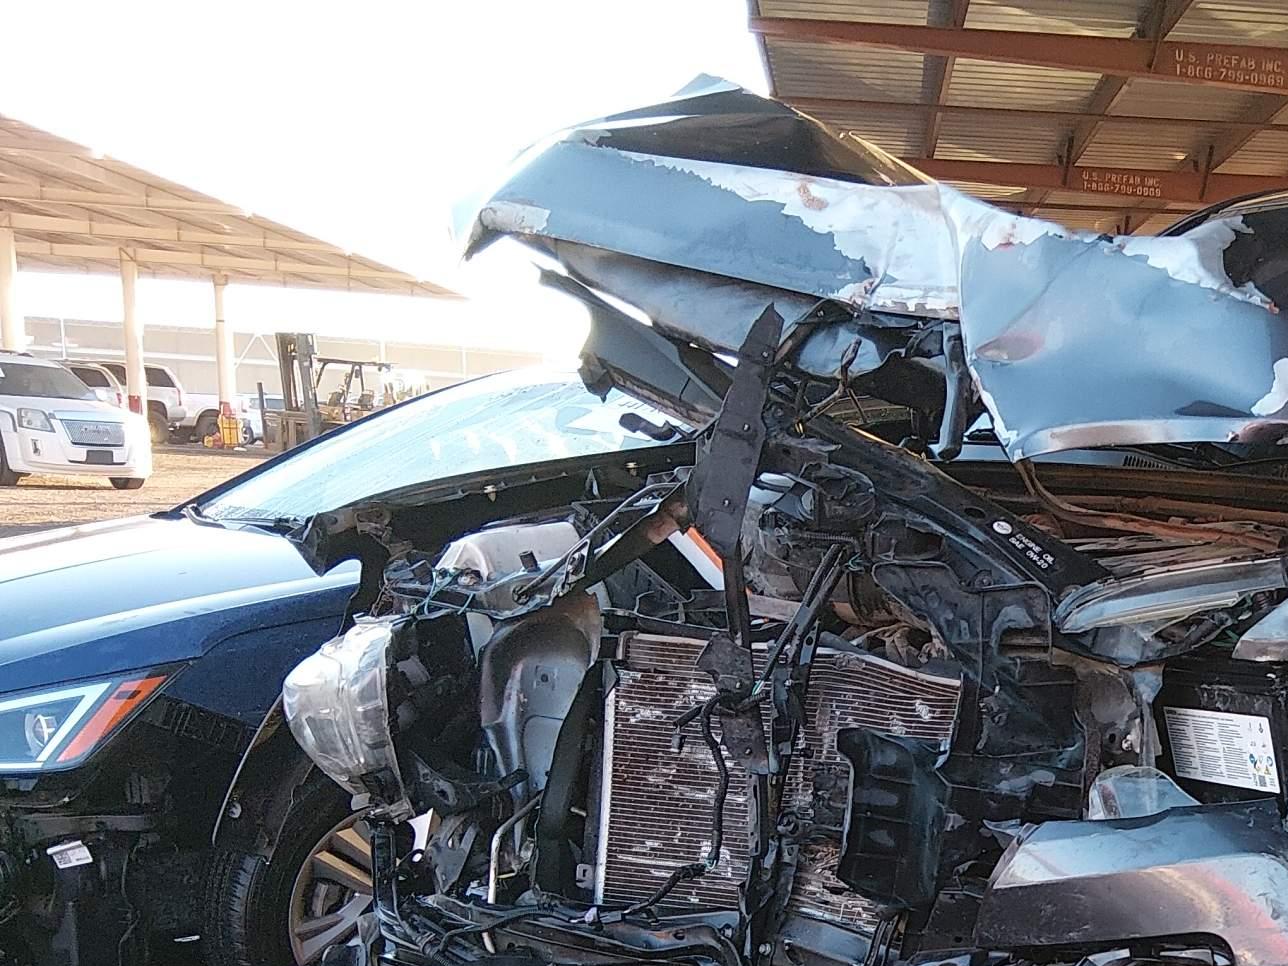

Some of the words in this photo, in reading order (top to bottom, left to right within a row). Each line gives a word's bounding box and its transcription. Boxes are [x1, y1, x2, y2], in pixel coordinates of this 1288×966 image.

[1175, 48, 1200, 64] U.S.
[1206, 53, 1256, 71] PREFAB
[1261, 60, 1286, 74] INC.
[1105, 172, 1141, 186] PREFAB
[1016, 534, 1042, 553] ENGINE
[1043, 554, 1054, 564] OIL
